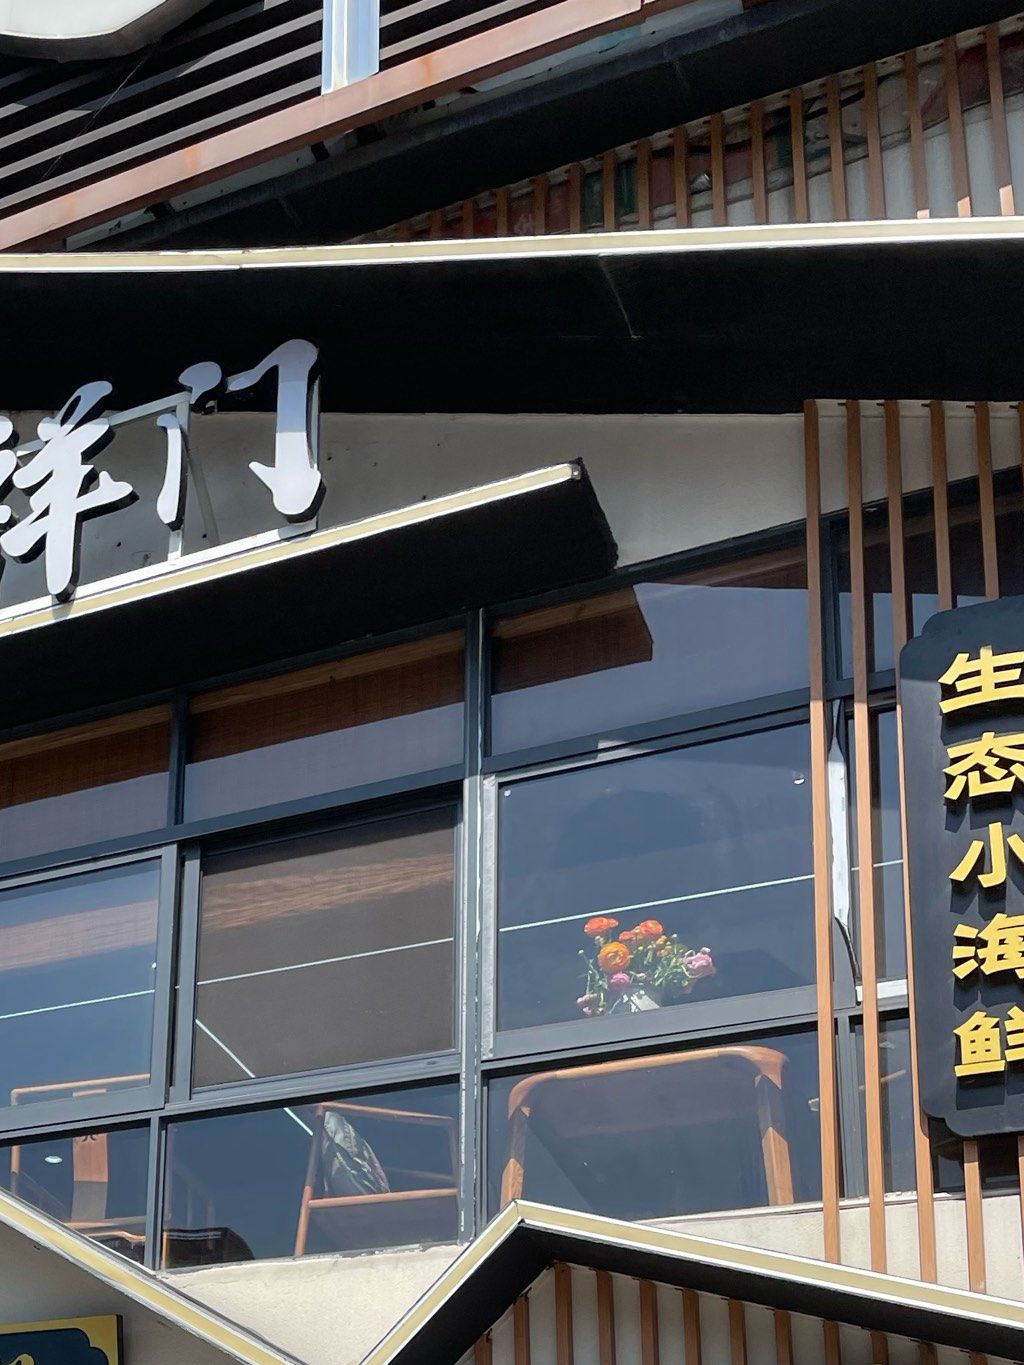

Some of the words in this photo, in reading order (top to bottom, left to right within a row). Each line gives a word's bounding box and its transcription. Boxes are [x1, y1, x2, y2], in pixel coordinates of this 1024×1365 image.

[938, 645, 1024, 1077] 生态小海鲜
